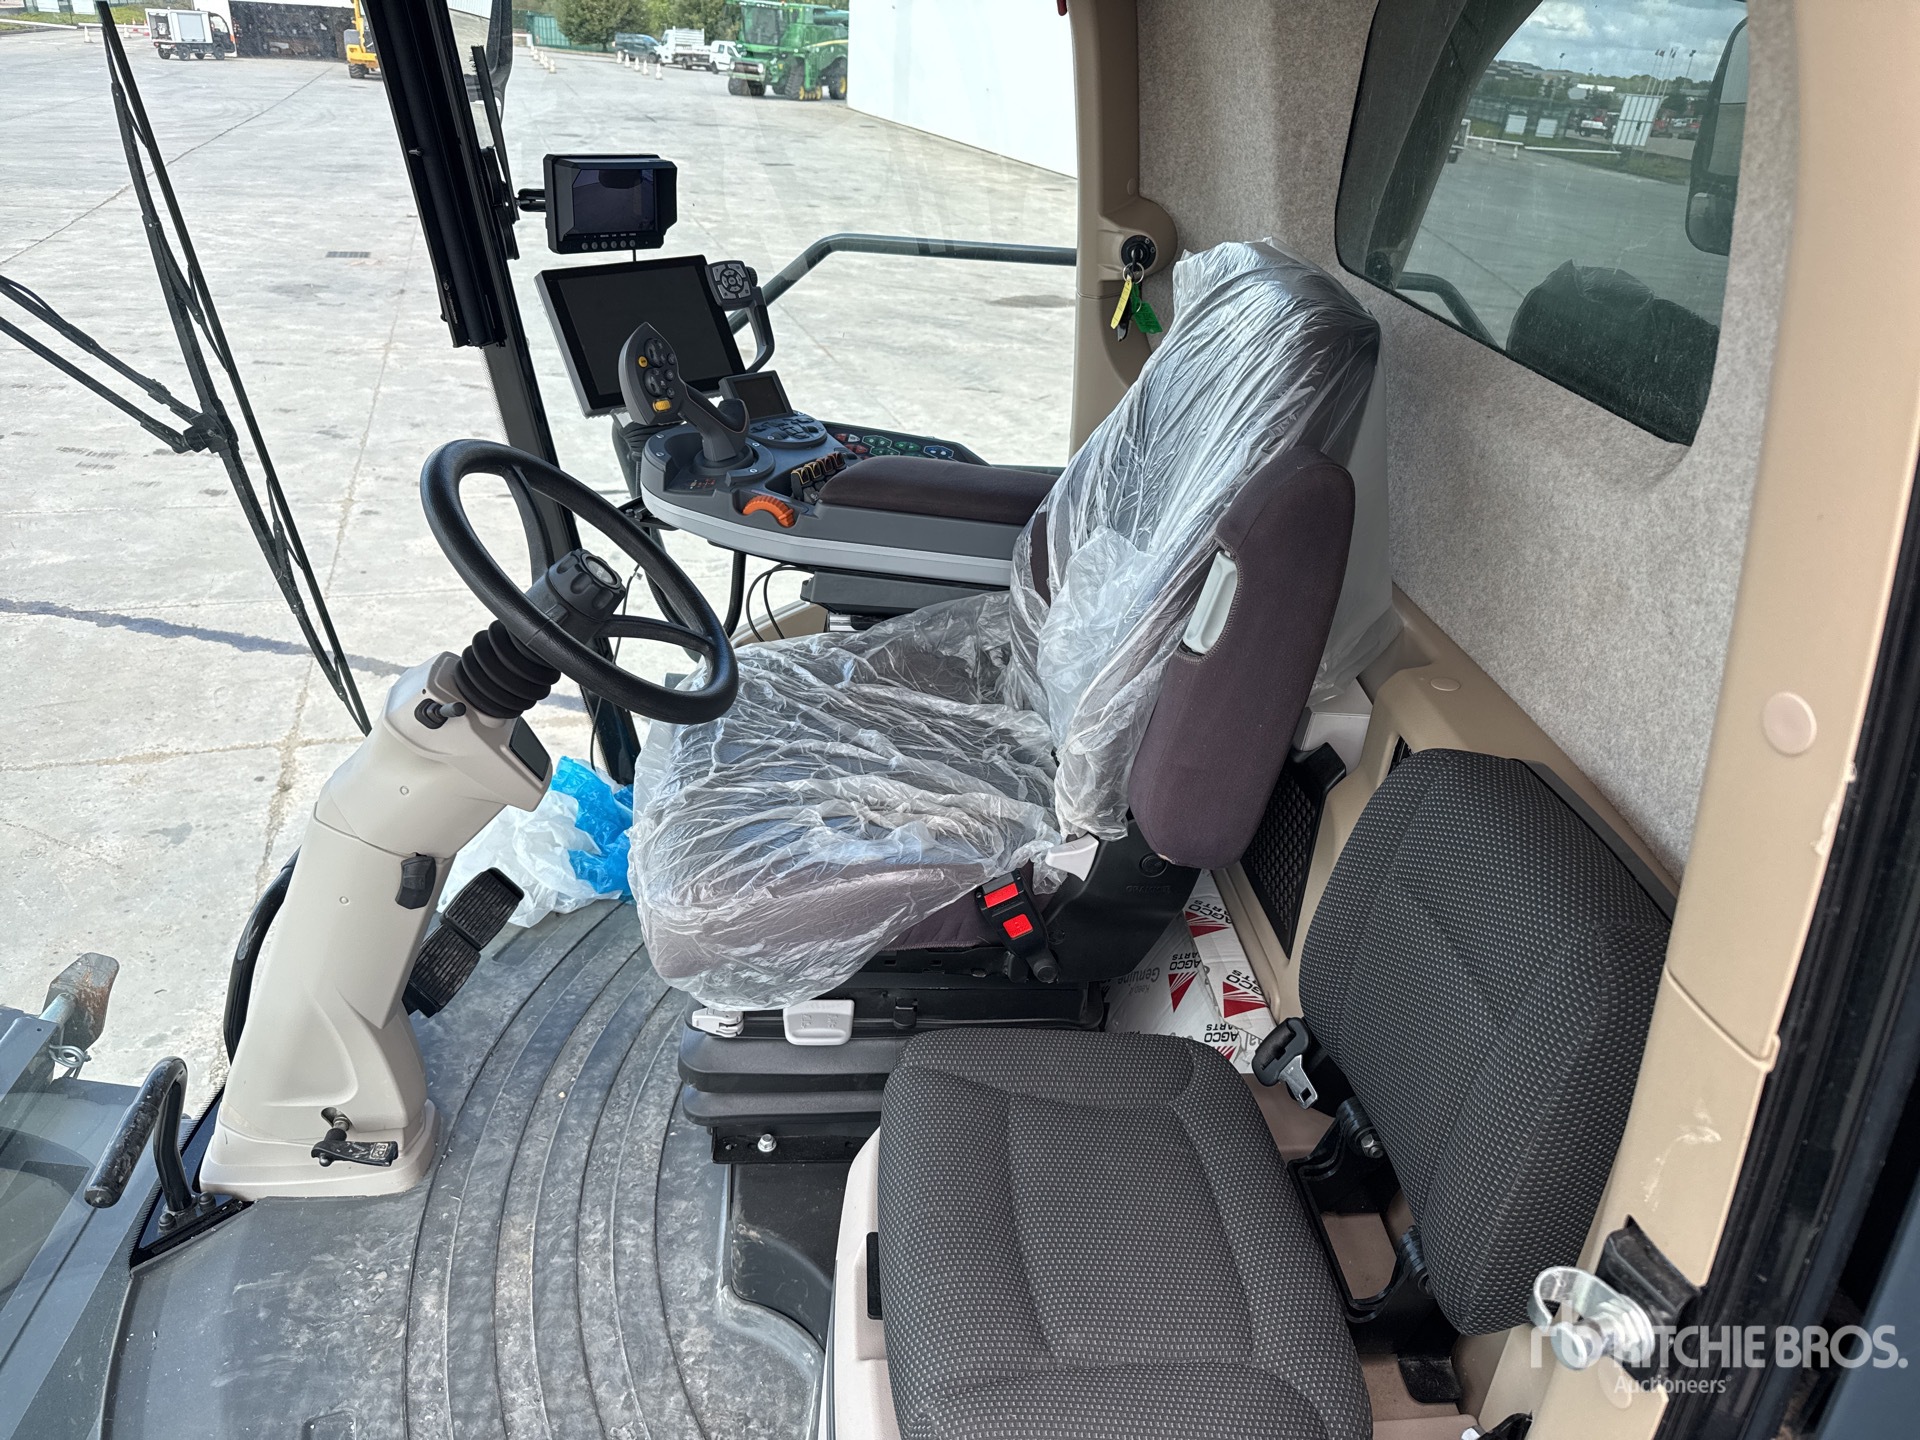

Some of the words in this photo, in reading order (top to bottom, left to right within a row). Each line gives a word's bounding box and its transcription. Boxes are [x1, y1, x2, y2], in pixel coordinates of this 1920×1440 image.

[1169, 959, 1201, 970] AGCO
[1226, 974, 1264, 996] GCO
[1203, 1031, 1240, 1043] AGCO
